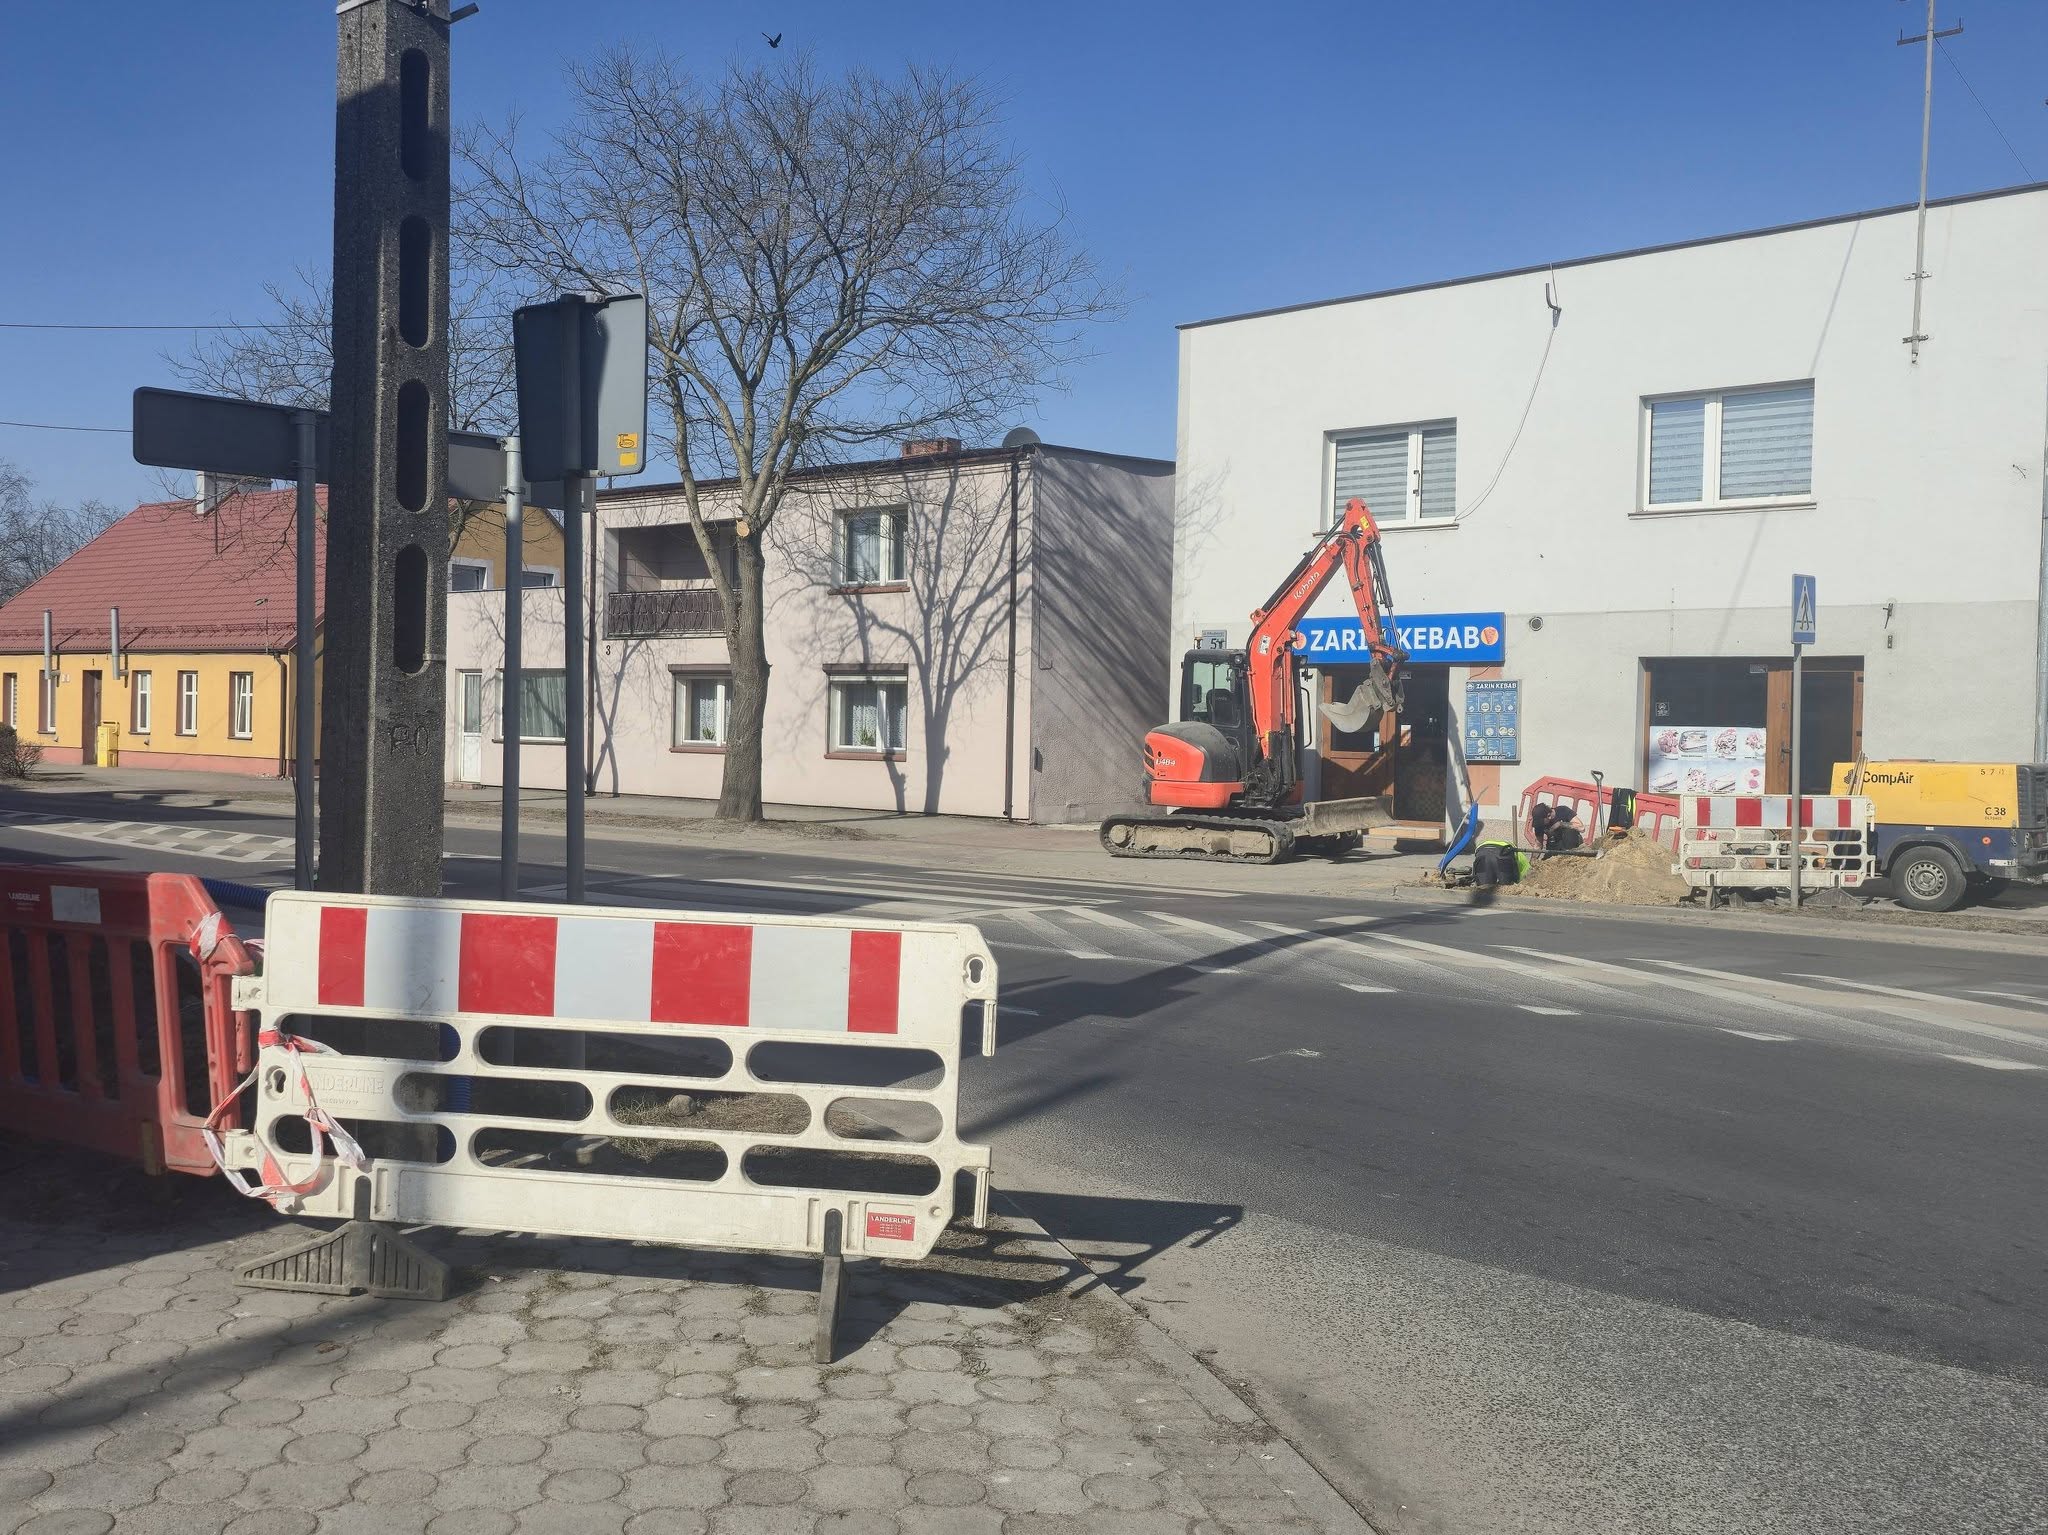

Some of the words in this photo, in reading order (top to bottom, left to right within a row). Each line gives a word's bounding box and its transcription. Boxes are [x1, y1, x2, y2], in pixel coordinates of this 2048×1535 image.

[1293, 571, 1320, 600] Kubota
[1397, 626, 1480, 650] KEBAB
[605, 644, 611, 656] 3
[1863, 771, 1914, 786] CompAir
